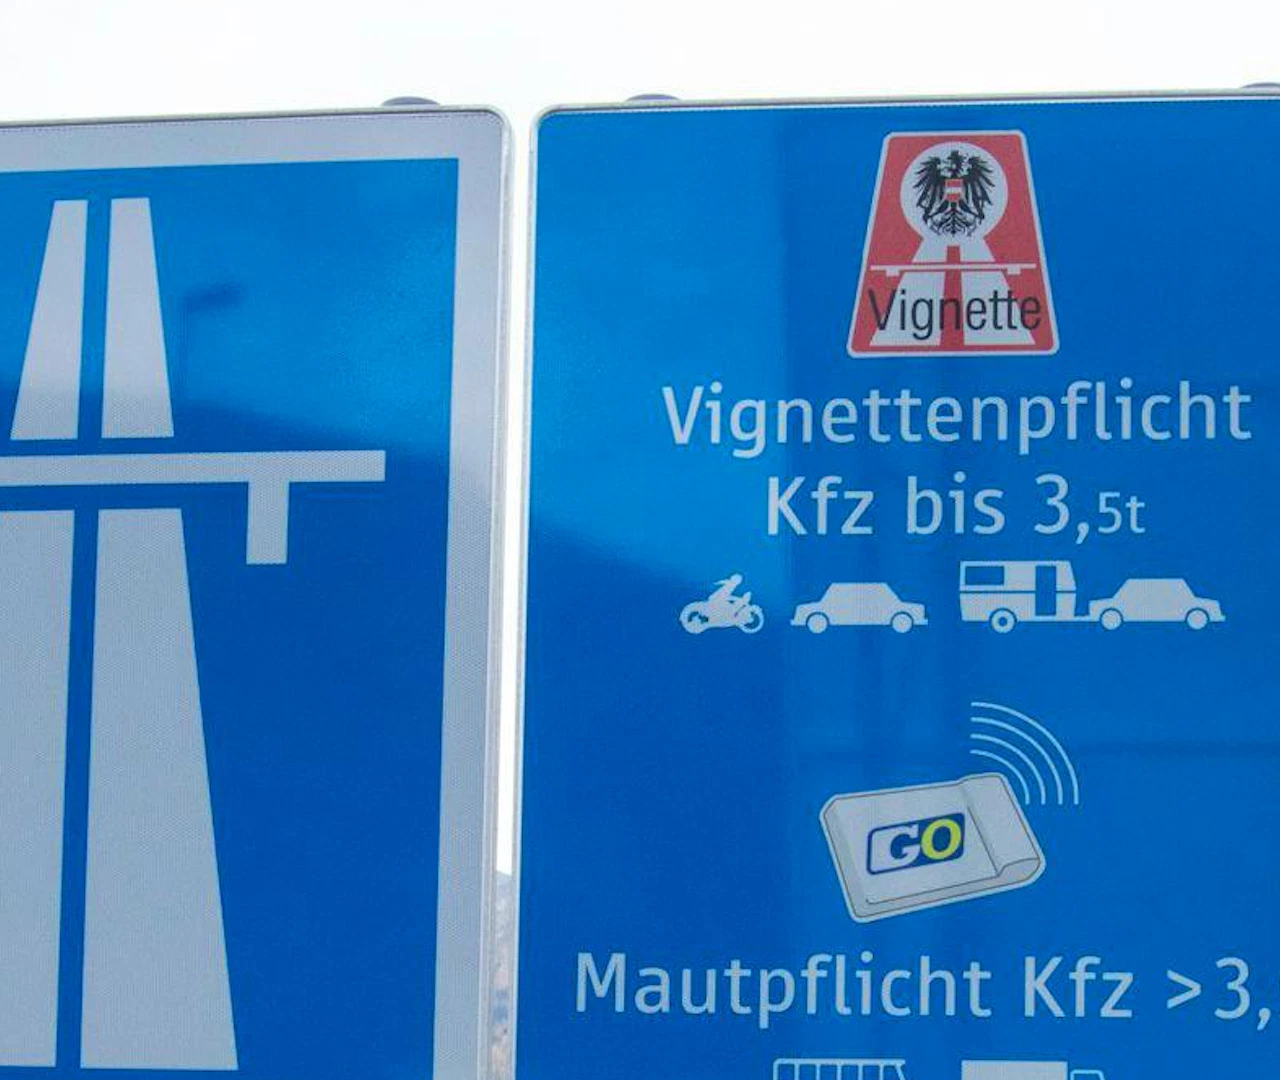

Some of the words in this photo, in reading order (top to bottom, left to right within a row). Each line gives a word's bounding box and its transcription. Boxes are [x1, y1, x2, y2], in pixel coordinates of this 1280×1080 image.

[867, 287, 1041, 341] Vignette
[661, 378, 1252, 459] Vignettenpflicht
[767, 475, 874, 536] Kfz
[906, 471, 1006, 535] bis
[1034, 473, 1145, 545] 3,5t
[875, 816, 963, 870] GO
[576, 951, 992, 1029] Mautpflicht
[1024, 955, 1134, 1018] Kfz
